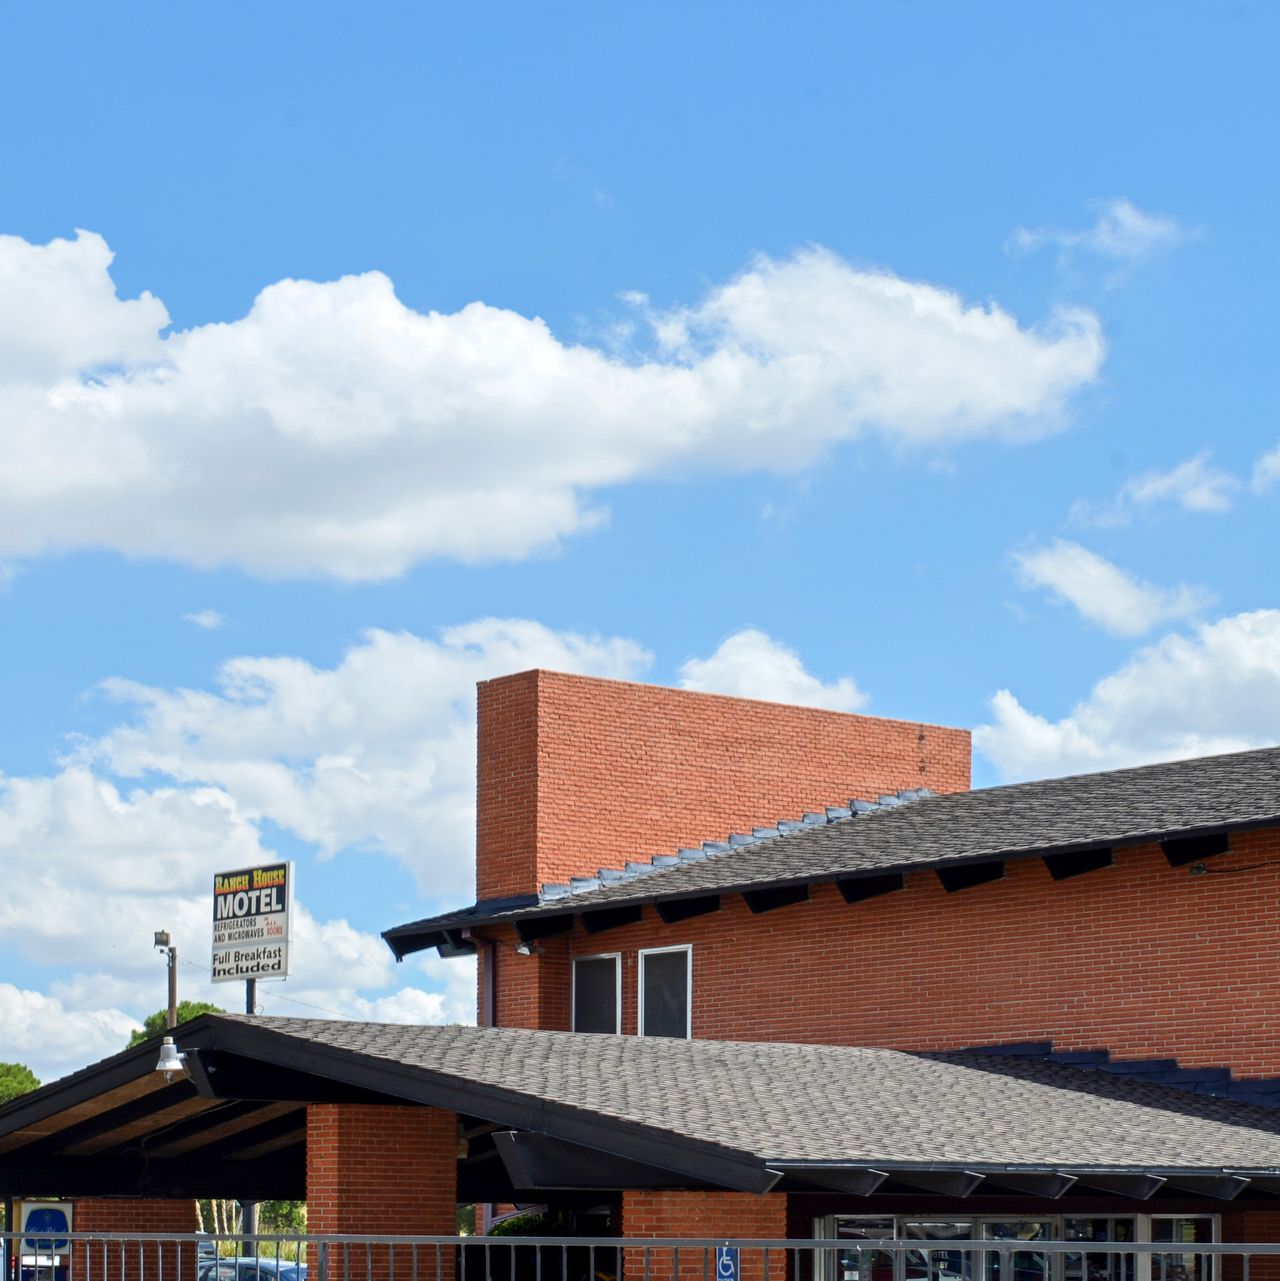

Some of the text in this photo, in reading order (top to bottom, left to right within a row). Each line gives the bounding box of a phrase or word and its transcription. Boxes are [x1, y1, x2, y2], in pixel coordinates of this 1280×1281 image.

[217, 887, 282, 919] MOTEL
[214, 917, 257, 933] REFRIGERATORS
[214, 927, 264, 944] AND MICROWAVES
[213, 946, 282, 966] Full Breakfast
